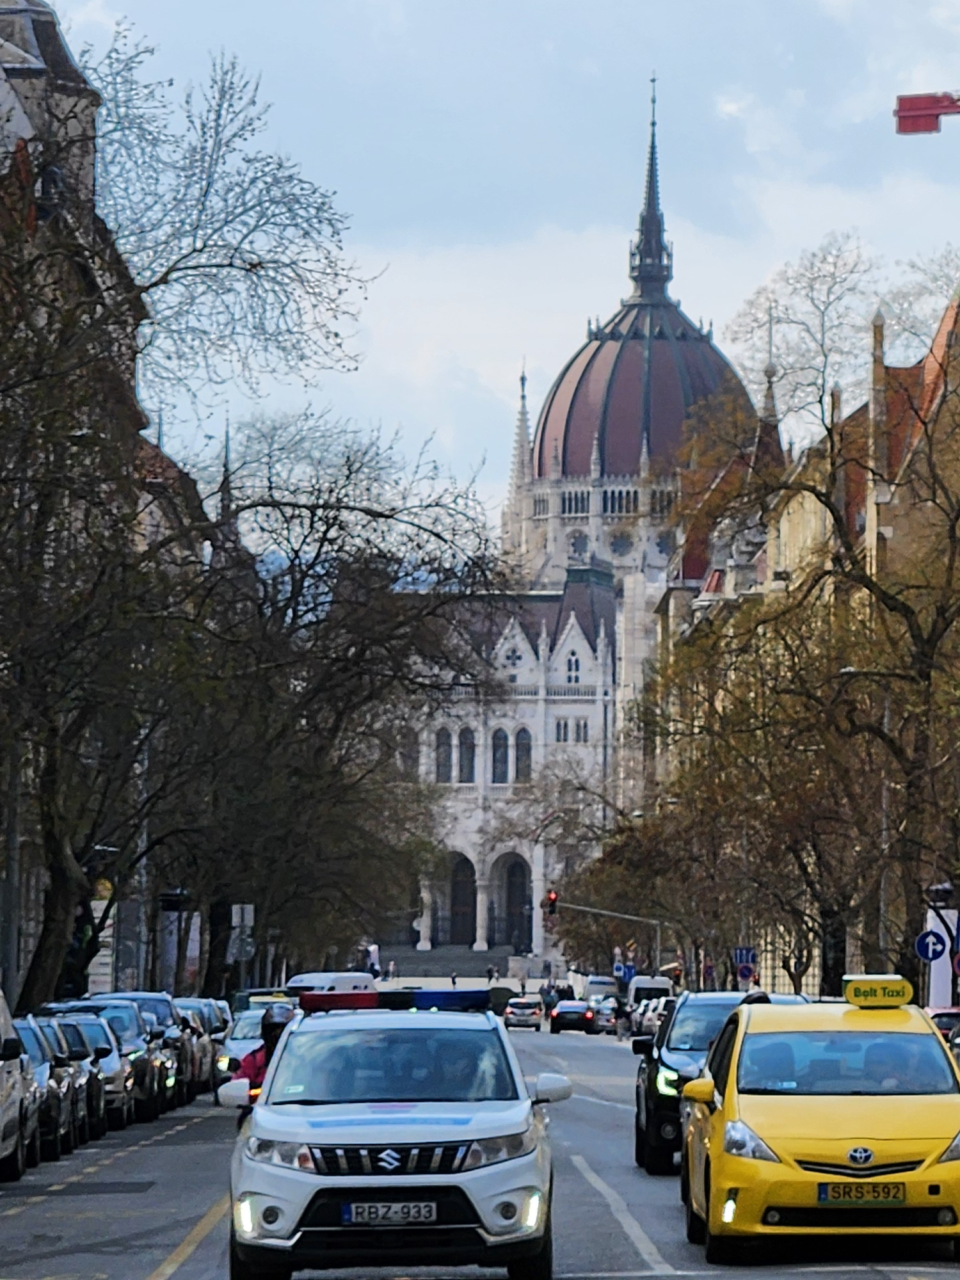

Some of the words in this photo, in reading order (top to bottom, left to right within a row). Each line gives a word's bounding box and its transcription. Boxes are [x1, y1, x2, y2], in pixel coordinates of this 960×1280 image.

[854, 986, 877, 1000] Bolt
[881, 986, 905, 998] Taxi
[831, 1185, 900, 1199] SRS-592
[354, 1204, 433, 1220] RBZ-933
